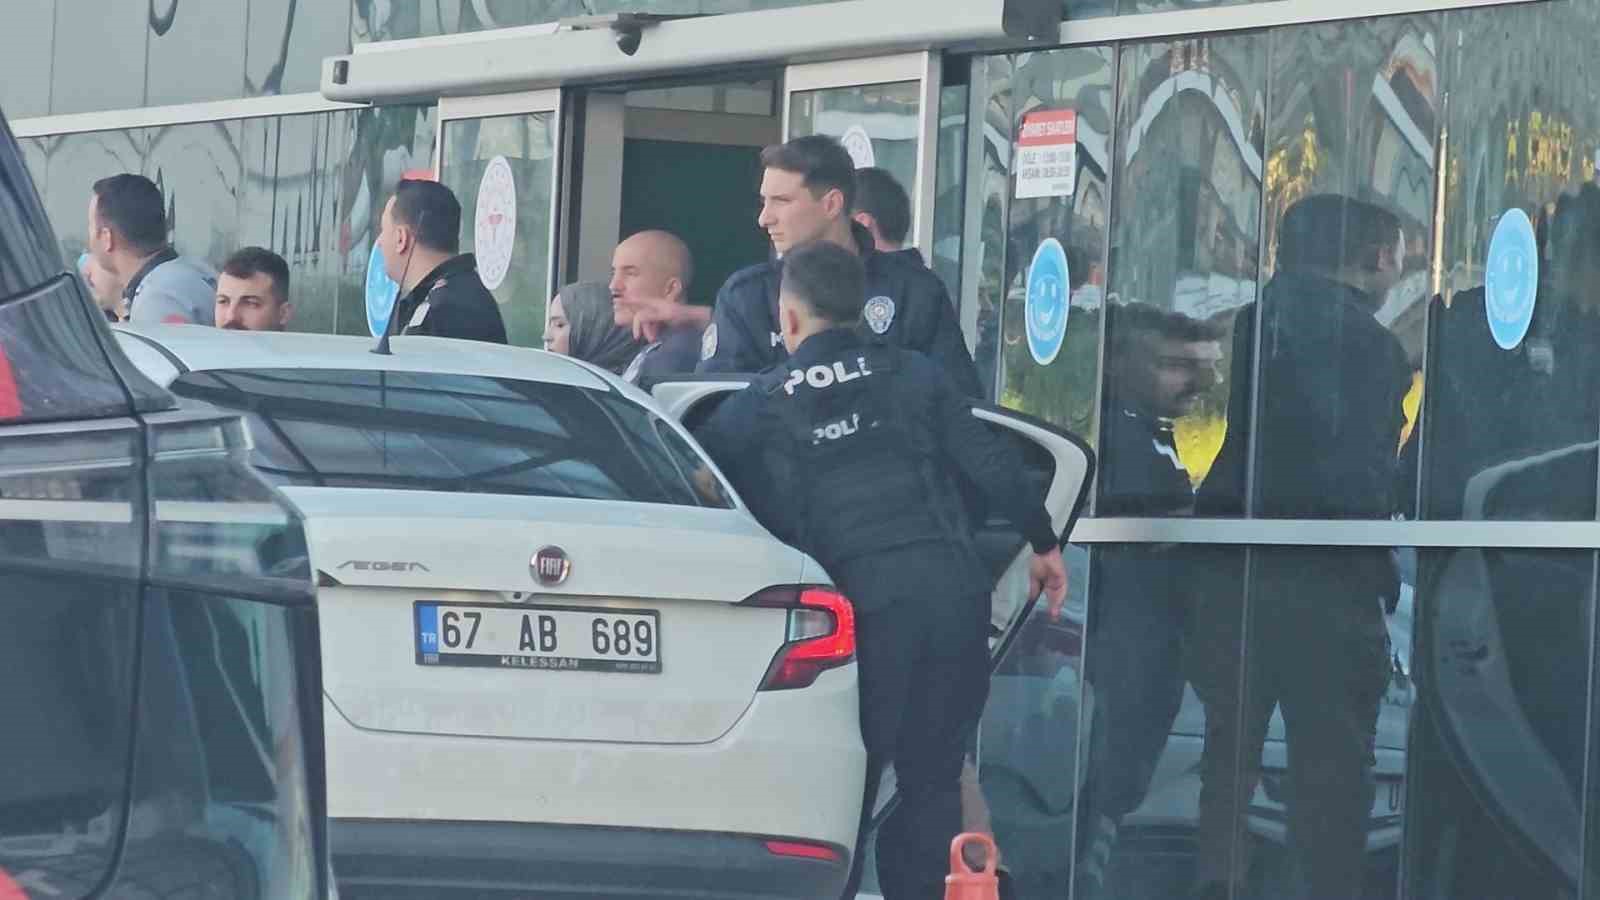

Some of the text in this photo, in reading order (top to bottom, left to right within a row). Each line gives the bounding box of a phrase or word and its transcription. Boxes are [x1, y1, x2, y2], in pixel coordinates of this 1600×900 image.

[540, 557, 562, 576] FIAT
[421, 632, 437, 645] TR
[441, 611, 653, 657] 67 AB 689
